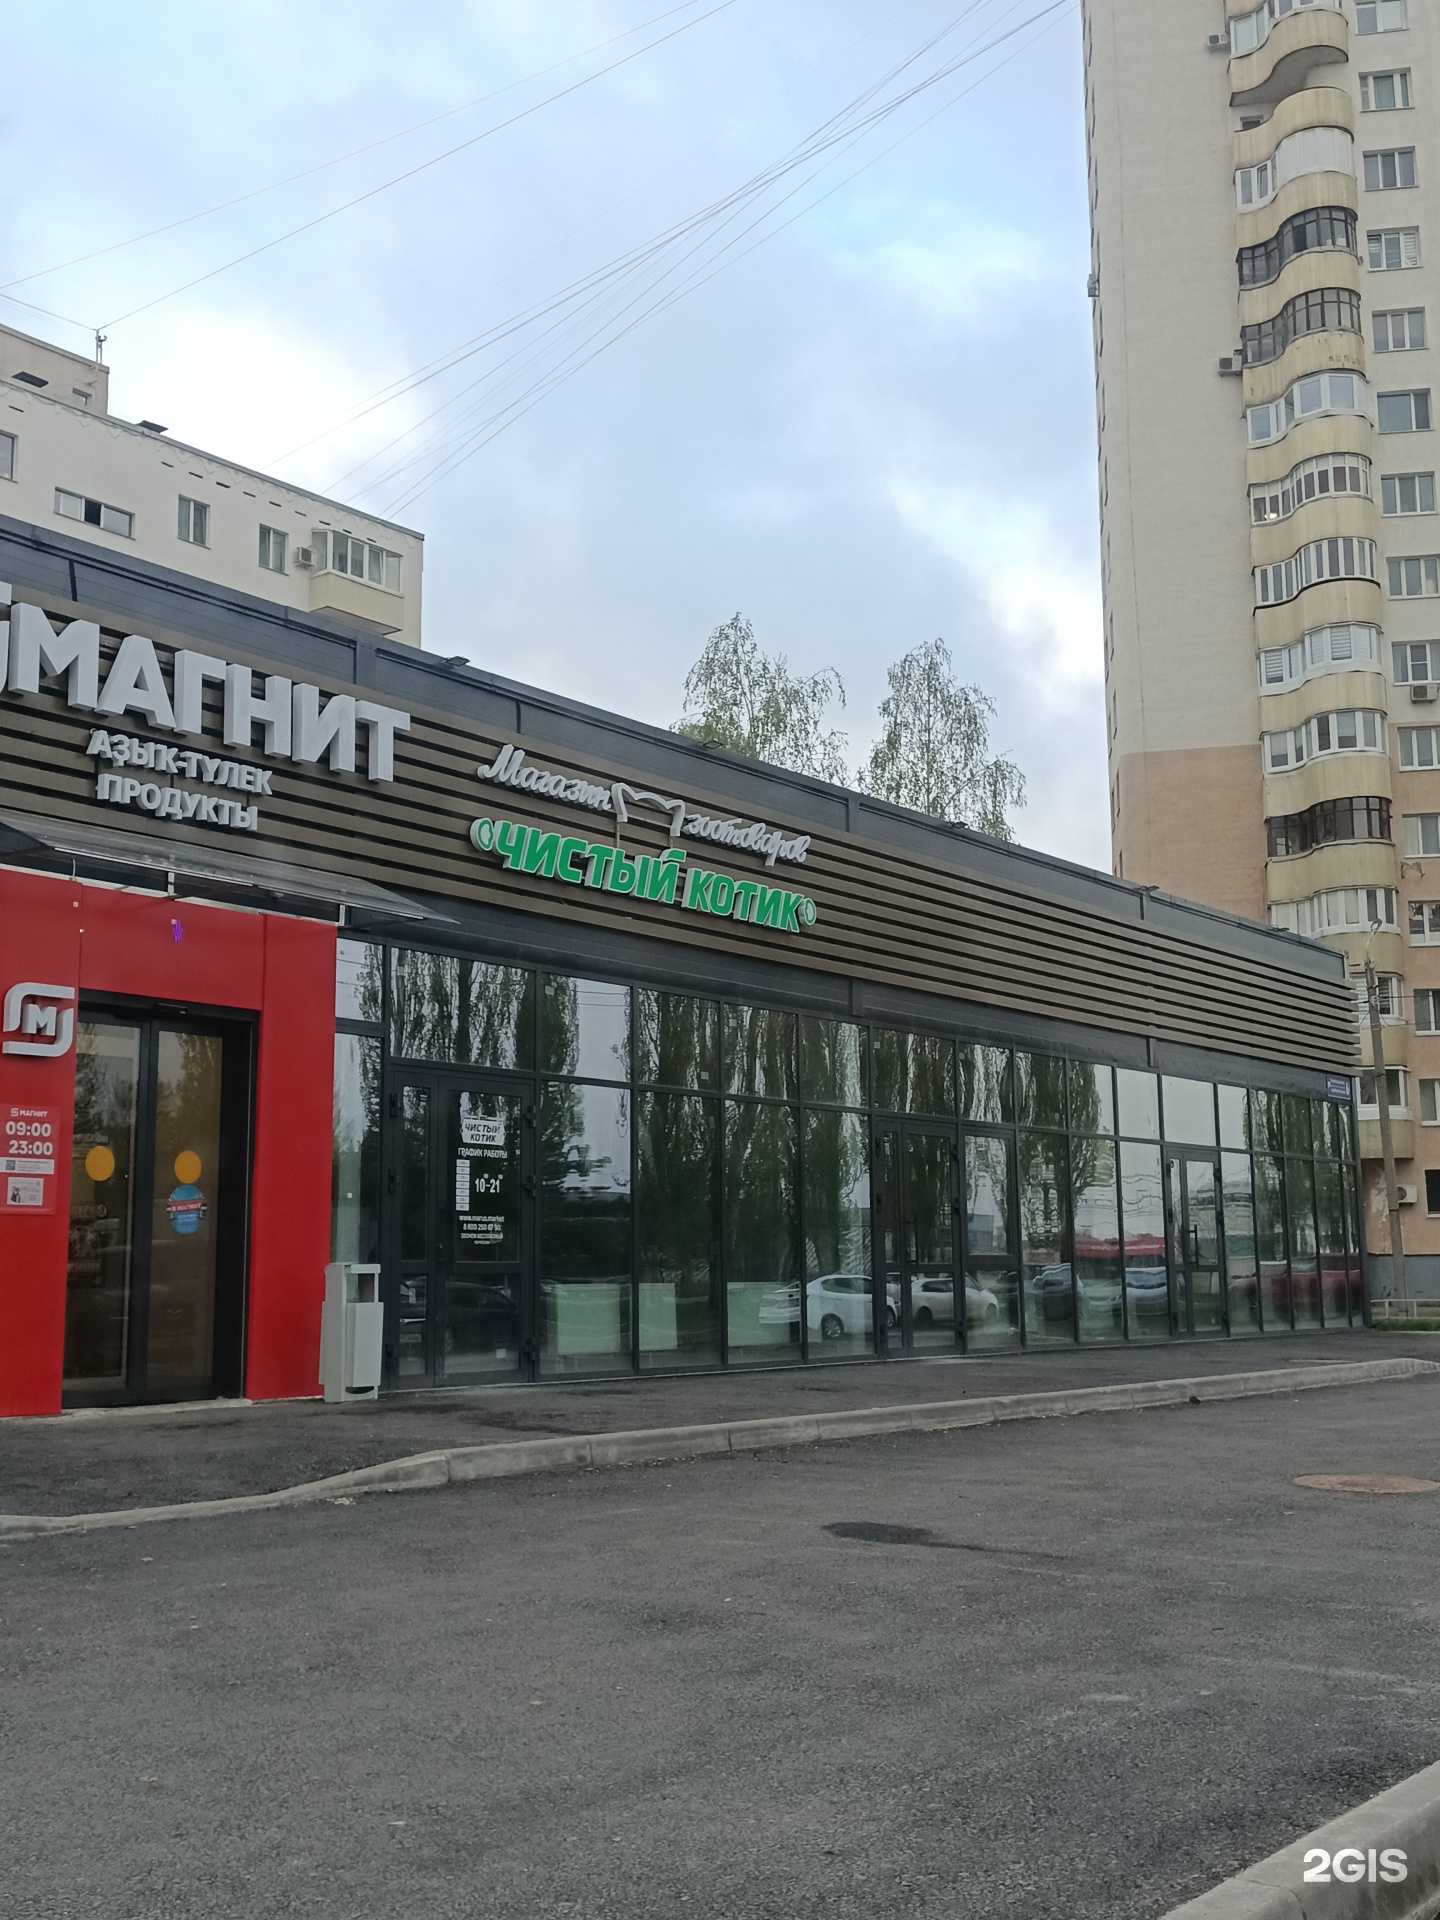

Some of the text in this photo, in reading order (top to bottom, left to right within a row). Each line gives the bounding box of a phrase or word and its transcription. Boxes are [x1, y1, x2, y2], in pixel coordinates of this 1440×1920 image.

[8, 601, 411, 783] МАГНИТ
[97, 773, 258, 832] ПРОДУКТЫ
[684, 814, 811, 867] зоотоваров
[496, 820, 803, 933] ЧИСТЫЙ КОТИК
[5, 1121, 52, 1137] 09:00
[465, 1123, 501, 1134] ЧИСТЫЙ
[470, 1133, 497, 1143] КОТИК
[9, 1140, 53, 1155] 23:00
[484, 1150, 508, 1159] РАБОТЫ
